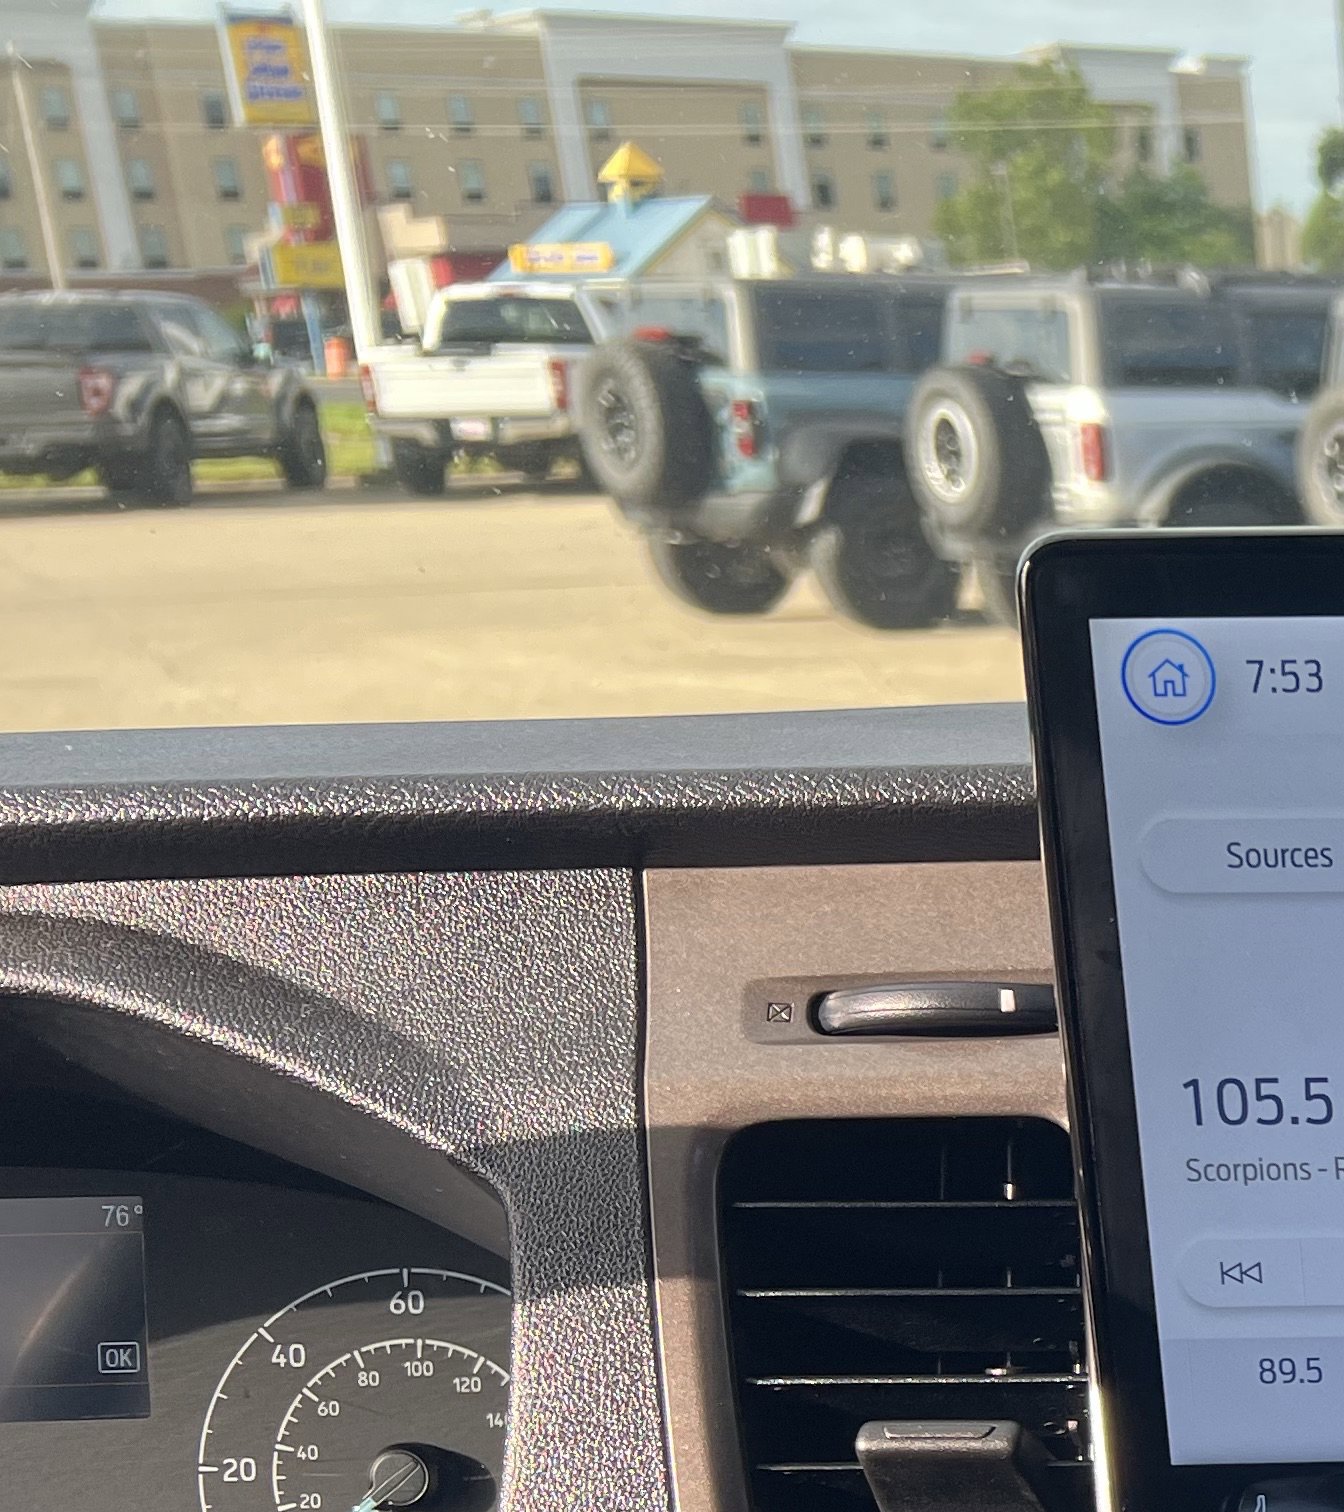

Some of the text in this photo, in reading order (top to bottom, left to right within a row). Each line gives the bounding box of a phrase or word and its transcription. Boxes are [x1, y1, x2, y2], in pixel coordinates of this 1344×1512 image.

[1245, 659, 1323, 694] 7:53
[1226, 841, 1334, 869] Sources
[1182, 1077, 1334, 1127] 105.5
[1185, 1157, 1312, 1187] Scorpions
[101, 1204, 143, 1227] 76°
[389, 1290, 425, 1315] 60
[105, 1347, 133, 1368] OK
[270, 1341, 307, 1368] 40
[357, 1370, 380, 1387] 80
[403, 1360, 434, 1377] 100
[1258, 1357, 1323, 1385] 89.5
[452, 1376, 482, 1393] 120
[316, 1398, 341, 1417] 60
[296, 1444, 319, 1461] 40
[222, 1457, 257, 1482] 20
[299, 1492, 322, 1509] 20
